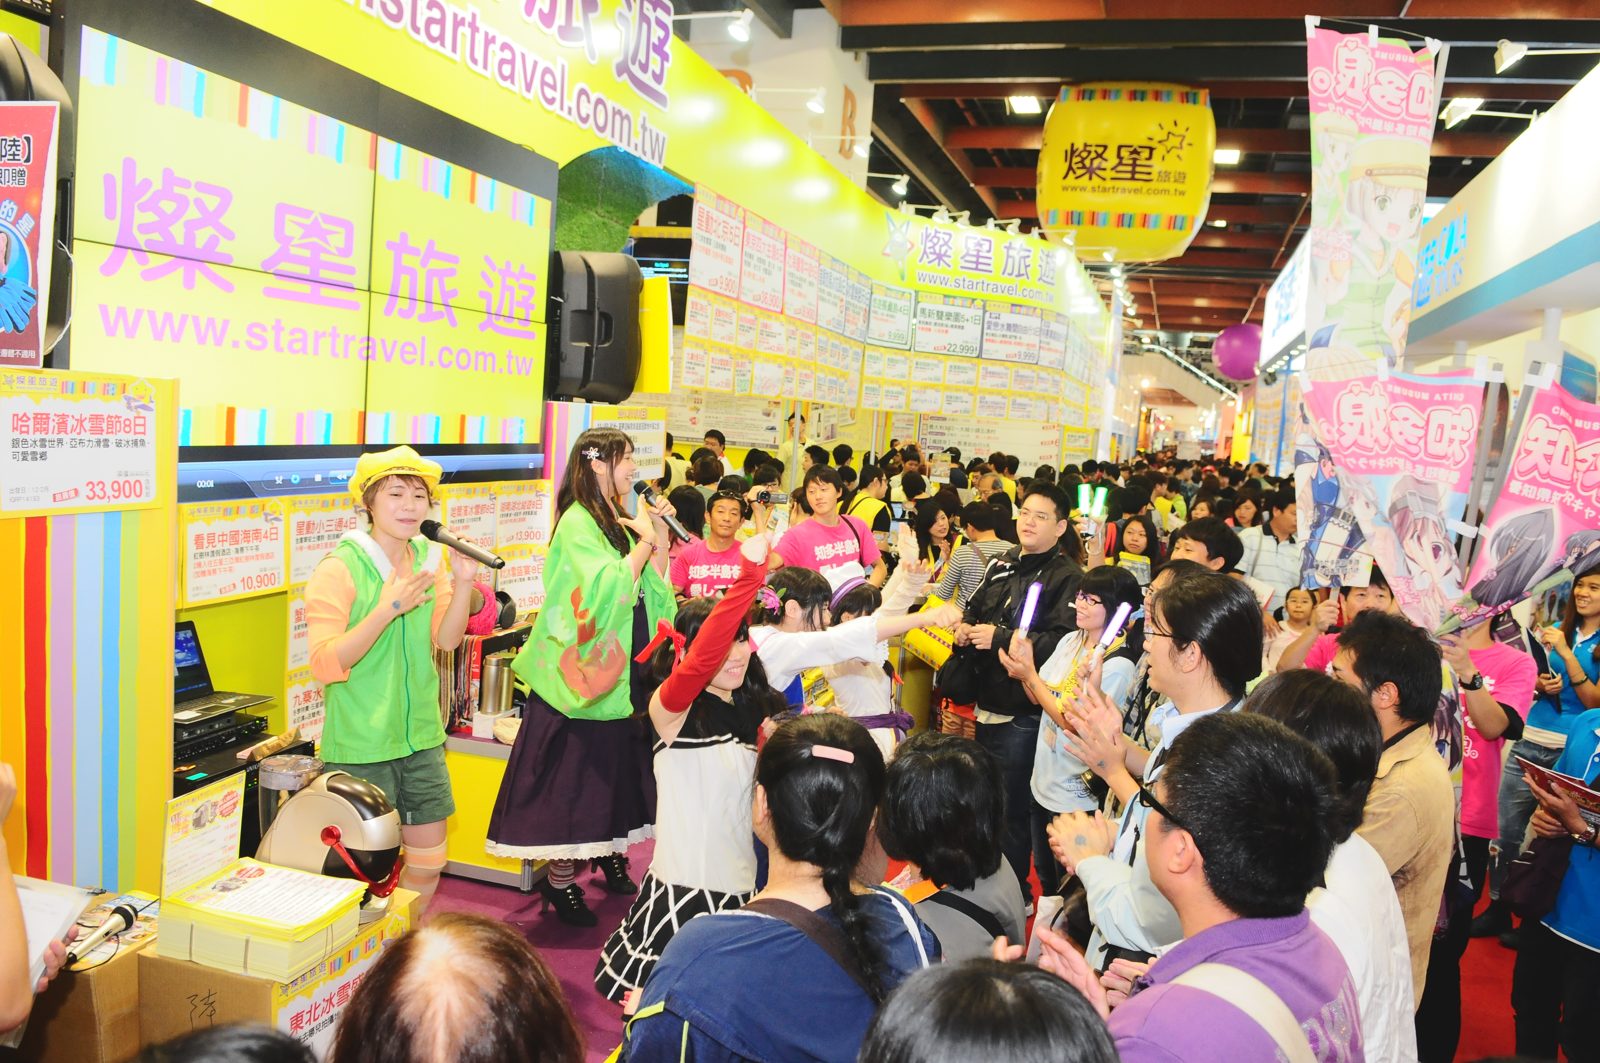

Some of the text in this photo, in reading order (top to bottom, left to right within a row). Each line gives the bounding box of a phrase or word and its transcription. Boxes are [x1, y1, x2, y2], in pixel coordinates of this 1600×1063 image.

[1062, 142, 1187, 185] 燦星 旅遊
[1061, 184, 1187, 198] www.startravel.com.tw
[99, 156, 537, 341] 燦星旅遊
[918, 227, 1056, 286] 燦星旅遊
[98, 303, 535, 377] www.startravel.com.tw
[11, 412, 147, 436] 哈爾濱冰雪節8日
[85, 479, 143, 503] 33,900
[193, 526, 280, 551] 看見中國海南4日
[295, 516, 358, 537] 星動小三通4日
[240, 572, 277, 592] 10,900
[688, 563, 742, 580] 知多半島を
